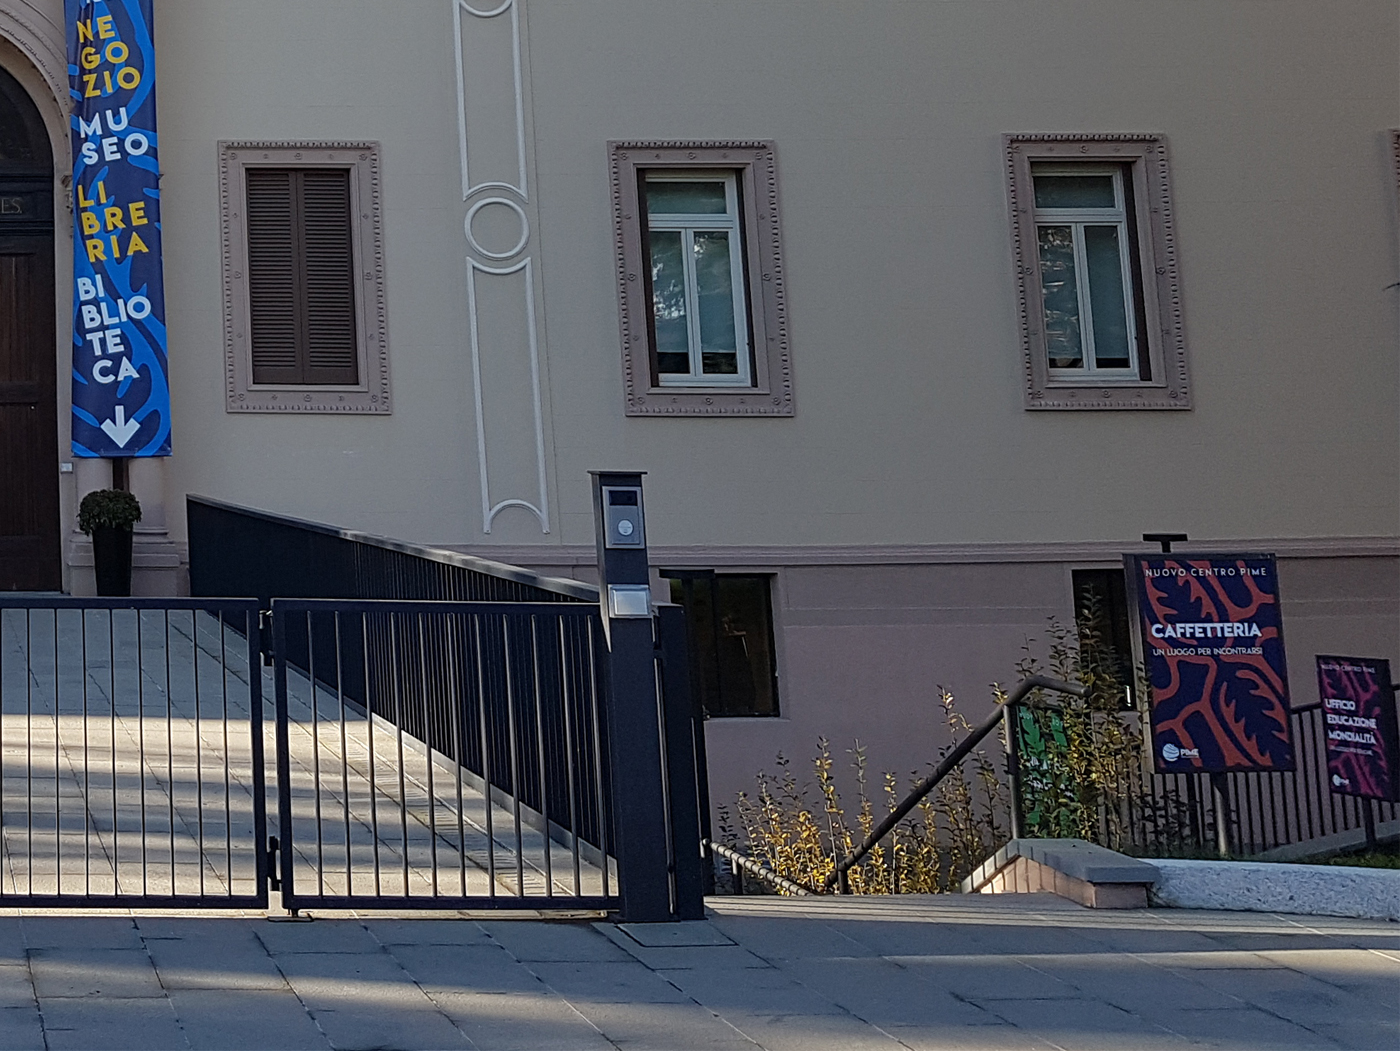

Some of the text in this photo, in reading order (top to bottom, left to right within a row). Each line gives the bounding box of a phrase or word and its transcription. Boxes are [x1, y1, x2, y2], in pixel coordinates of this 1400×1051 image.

[76, 14, 116, 43] NE
[81, 41, 129, 70] GO
[83, 66, 141, 98] ZIO
[79, 106, 129, 138] MU
[81, 132, 149, 165] SEO
[77, 181, 108, 208] LI
[81, 201, 148, 236] BRE
[86, 231, 150, 263] RIA
[77, 274, 105, 301] BI
[81, 295, 152, 329] BLIO
[86, 328, 125, 356] TE
[92, 356, 141, 384] CA
[1145, 567, 1267, 577] NUOVO CENTRO PIME
[1151, 622, 1263, 639] CAFFETTERIA
[1153, 647, 1263, 656] UN LUOGO PER INCONTRARSI
[1325, 698, 1356, 710] UFFICIO
[1327, 714, 1377, 729] EDUCAZIONE
